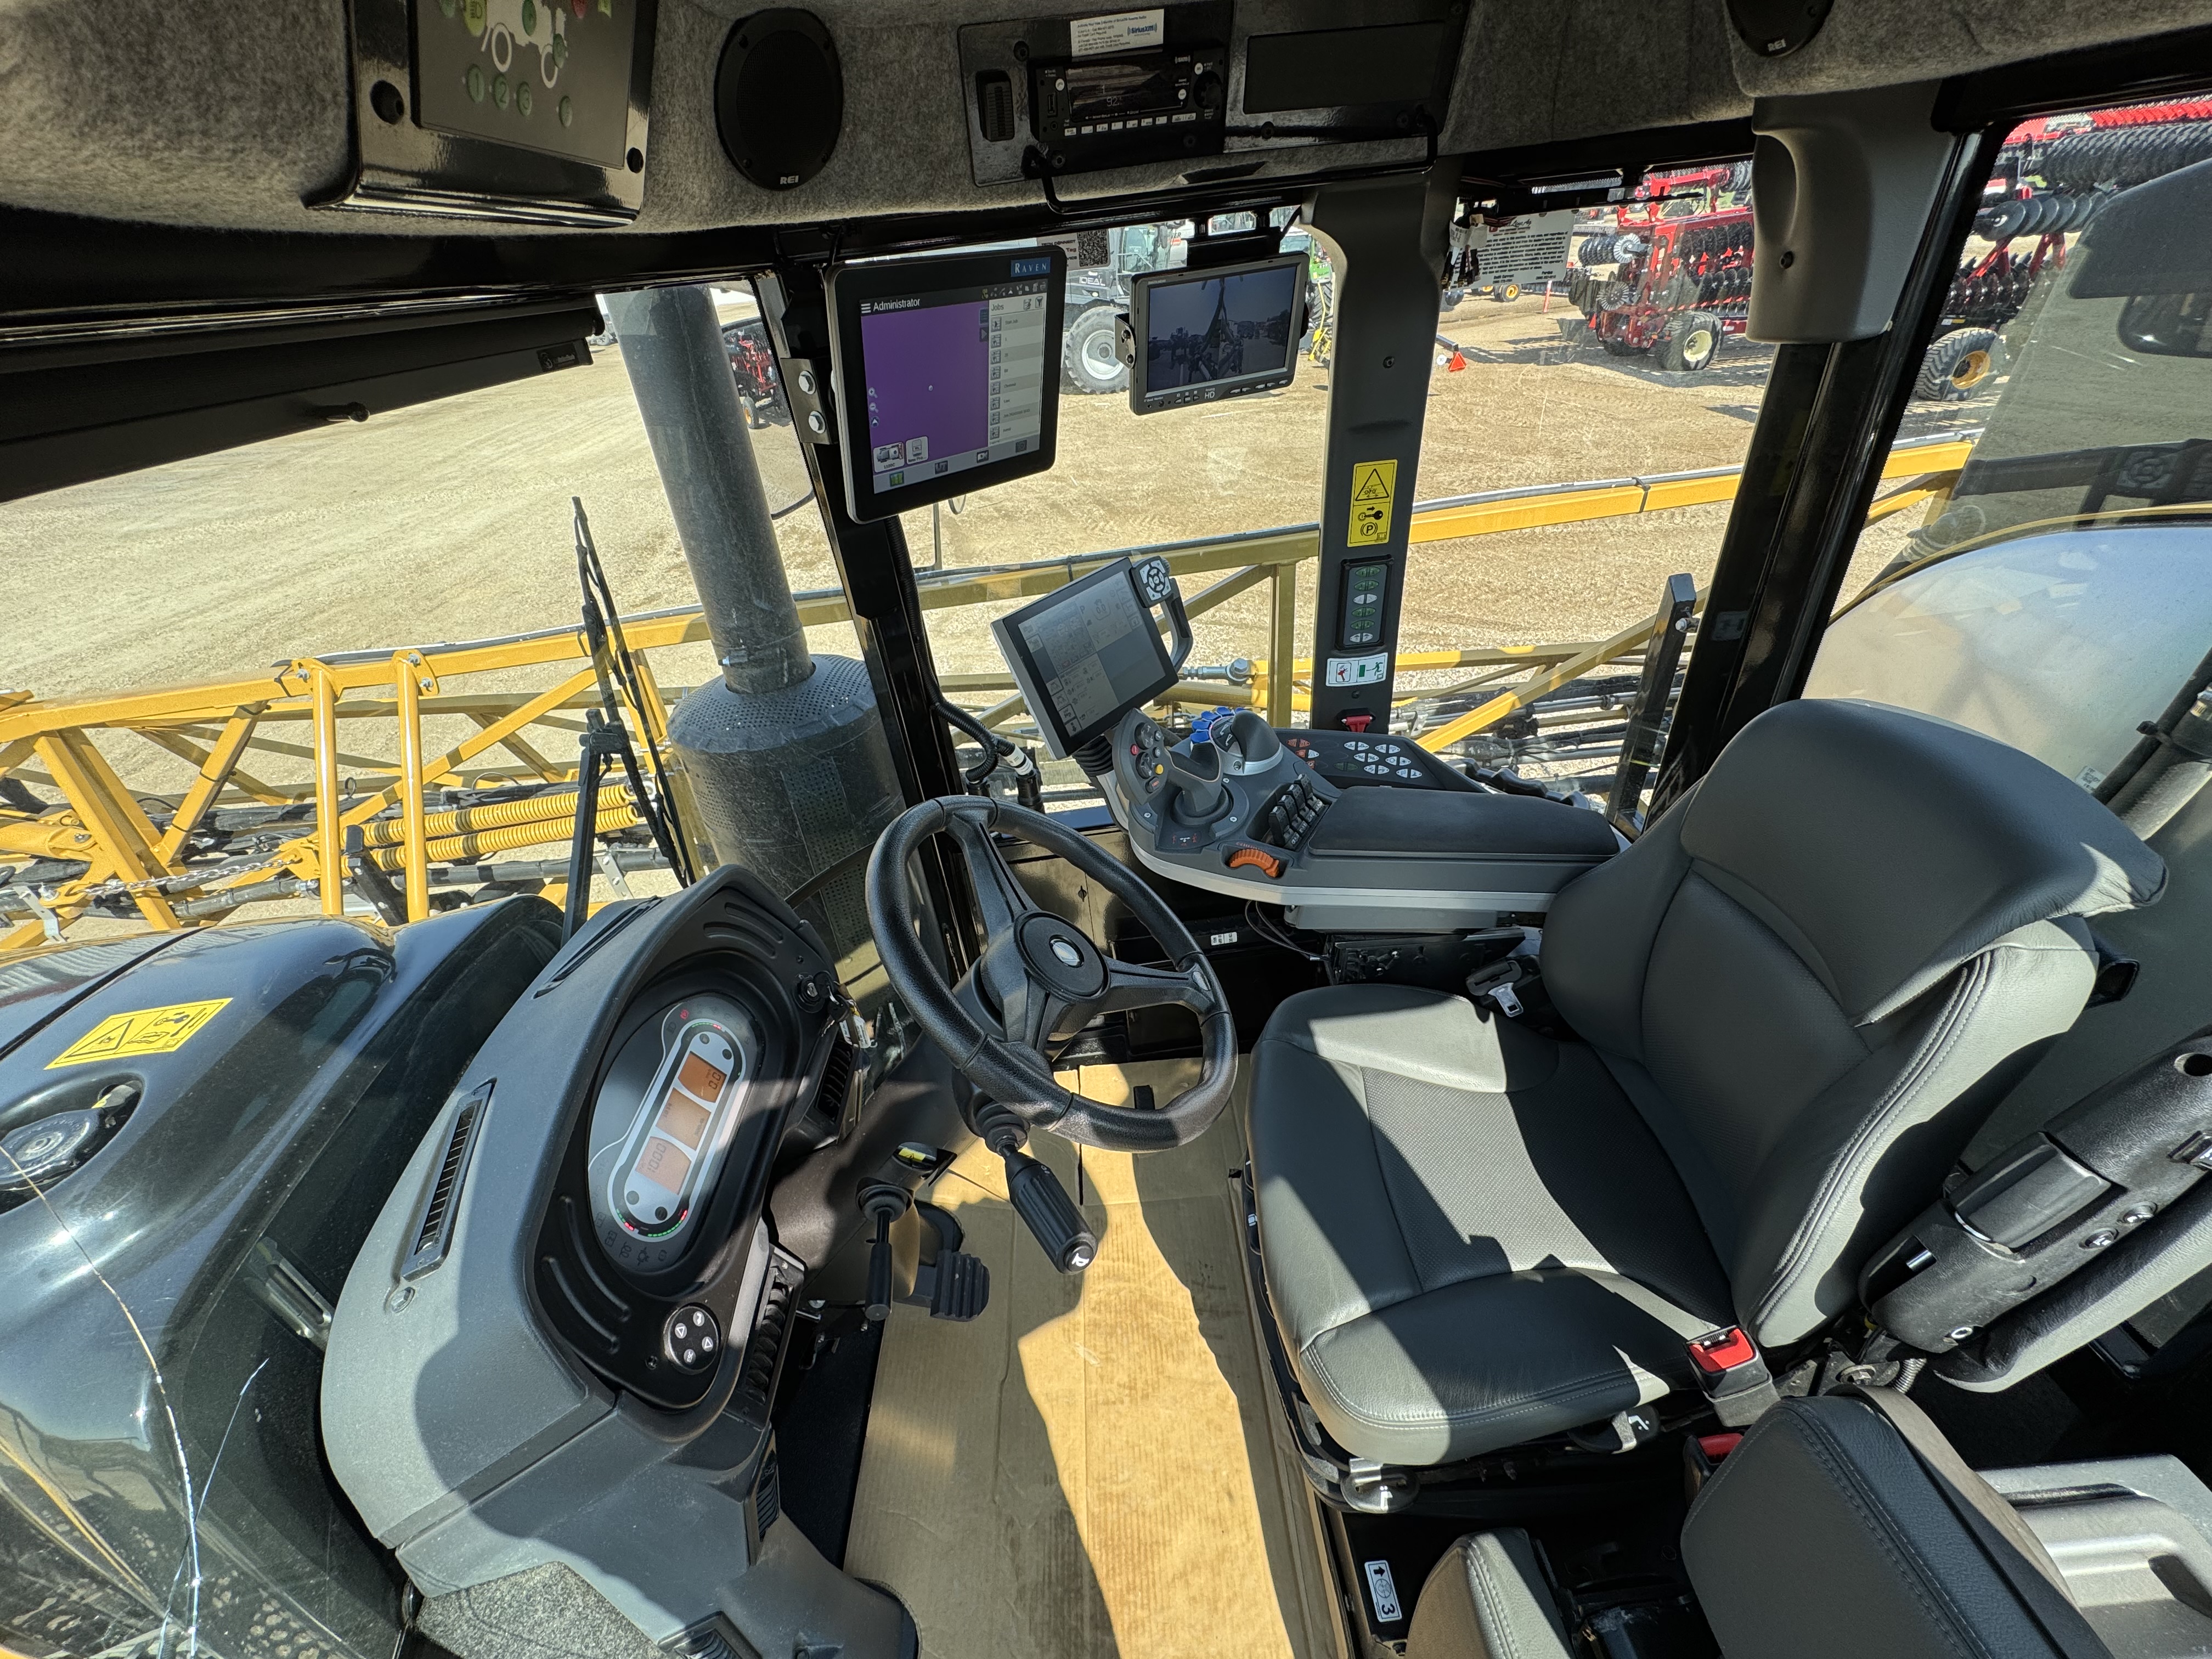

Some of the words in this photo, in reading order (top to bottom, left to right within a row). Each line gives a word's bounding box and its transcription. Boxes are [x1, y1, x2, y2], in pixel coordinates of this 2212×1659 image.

[1767, 38, 1787, 52] REI
[500, 81, 506, 103] 2
[523, 90, 529, 109] 3
[780, 175, 799, 185] REI
[1014, 263, 1047, 274] RAVEN
[1079, 276, 1106, 286] IDEAL
[873, 297, 921, 312] Administrator
[991, 303, 1004, 311] Jobs
[708, 1071, 721, 1090] 0.0
[648, 1142, 667, 1173] 1000
[686, 1351, 694, 1363] ESC
[1381, 1603, 1396, 1615] 3
